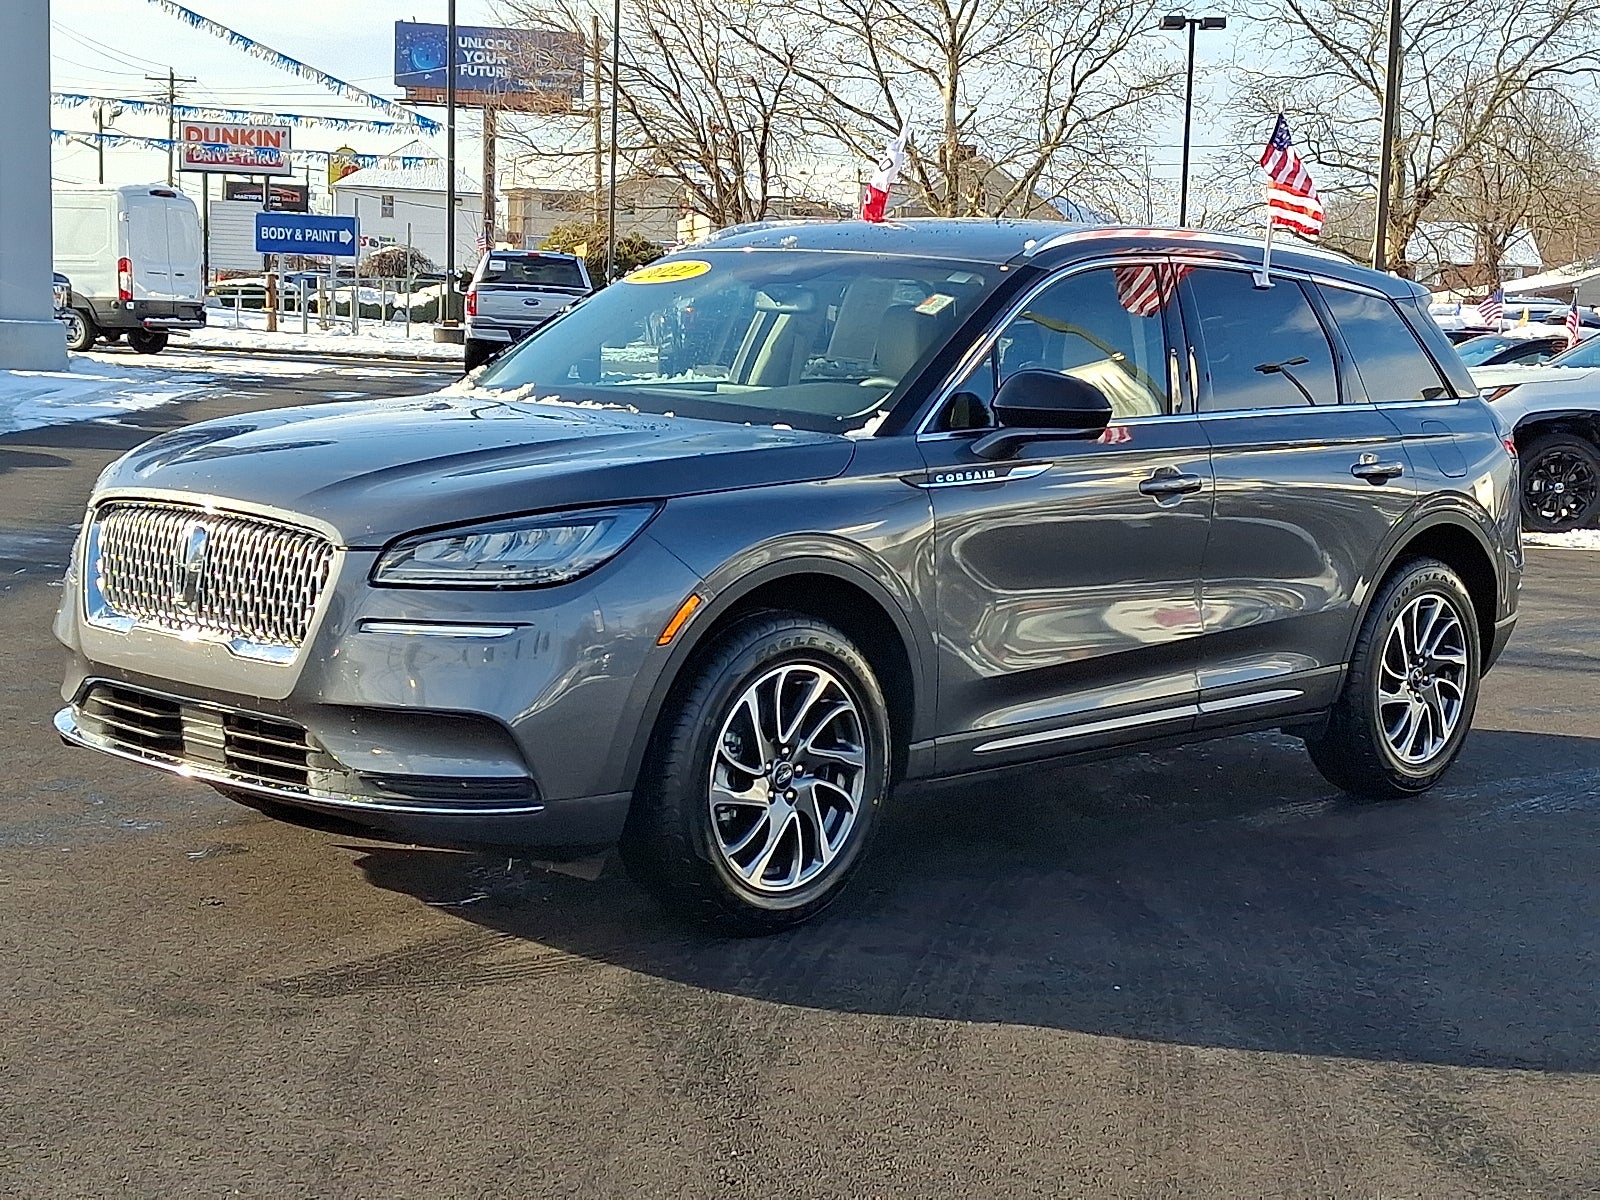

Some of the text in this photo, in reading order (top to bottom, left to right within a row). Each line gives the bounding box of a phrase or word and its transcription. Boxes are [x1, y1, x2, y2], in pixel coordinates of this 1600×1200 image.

[458, 36, 513, 51] UNLOCK
[462, 50, 508, 65] YOUR
[185, 126, 286, 147] DUNKIN'
[261, 226, 337, 243] BODY & PAINT
[935, 469, 996, 483] CORSAIR
[1386, 572, 1457, 622] GOODYEAR
[755, 636, 819, 664] EAGLE
